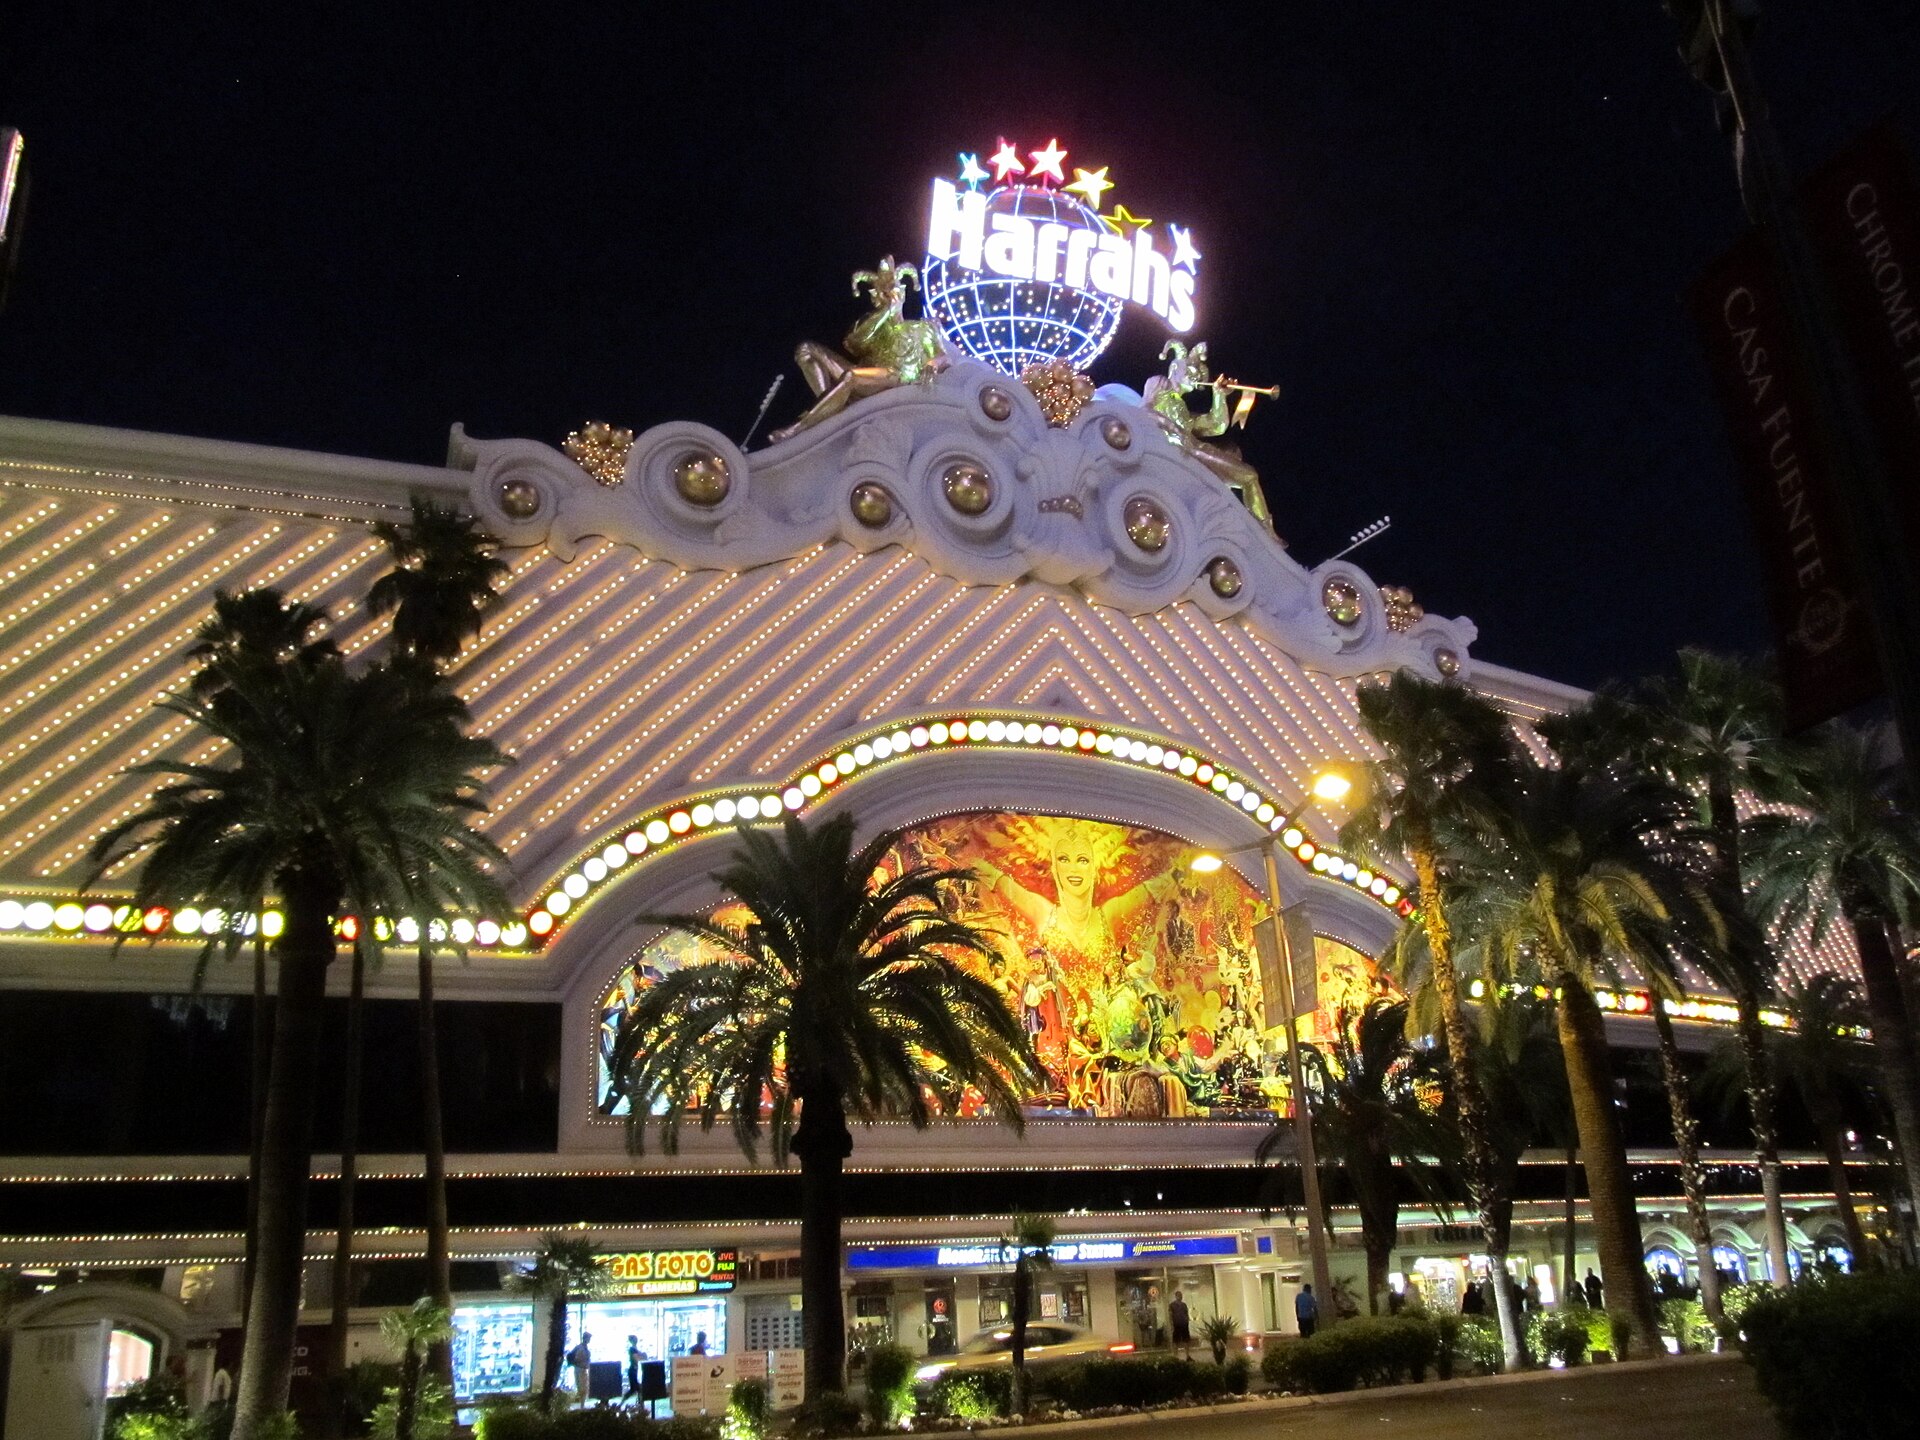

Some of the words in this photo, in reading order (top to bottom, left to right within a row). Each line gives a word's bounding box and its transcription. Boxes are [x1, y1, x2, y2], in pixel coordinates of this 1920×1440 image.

[1723, 286, 1774, 406] CASA
[1761, 406, 1825, 589] FUENTE
[591, 1253, 652, 1279] GAS
[656, 1251, 714, 1278] FOTO
[718, 1252, 734, 1261] JVC
[717, 1262, 735, 1271] FUJI
